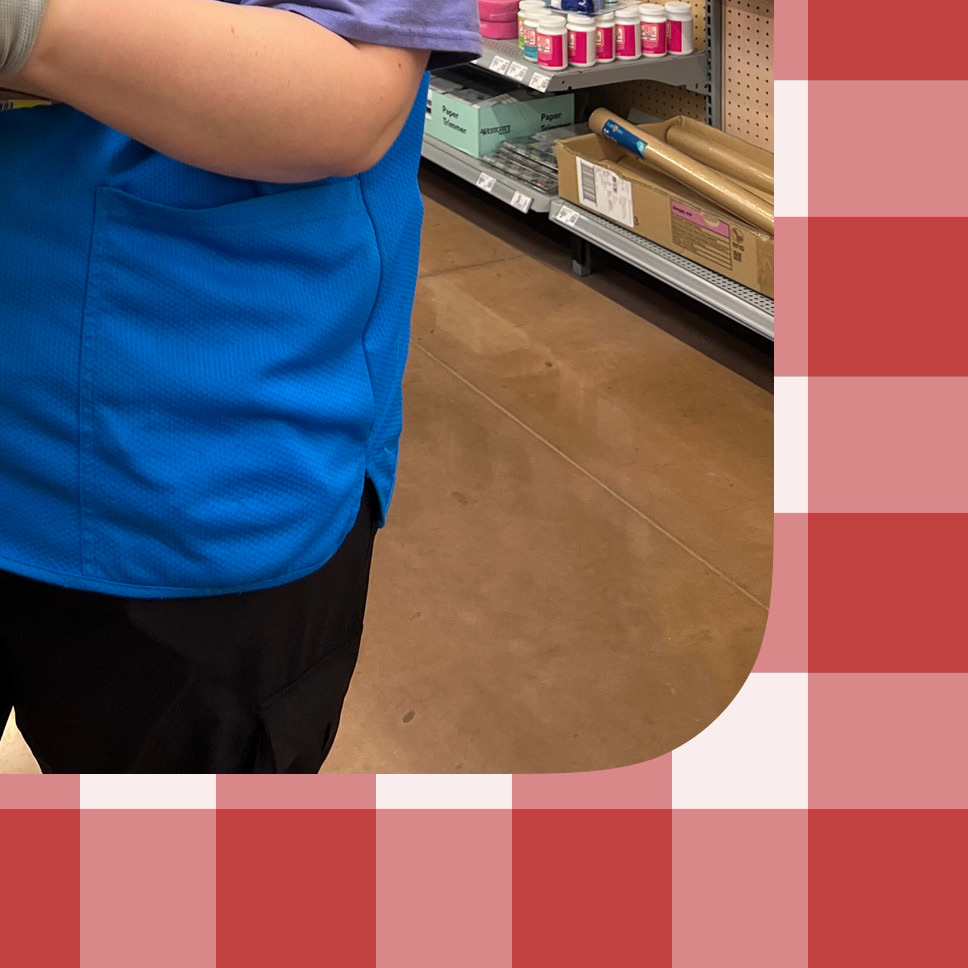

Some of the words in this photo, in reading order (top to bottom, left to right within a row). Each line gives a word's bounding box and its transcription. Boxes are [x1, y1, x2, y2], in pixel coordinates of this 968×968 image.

[442, 105, 459, 119] Paper
[541, 112, 562, 121] Paper
[442, 117, 466, 134] Trimmer
